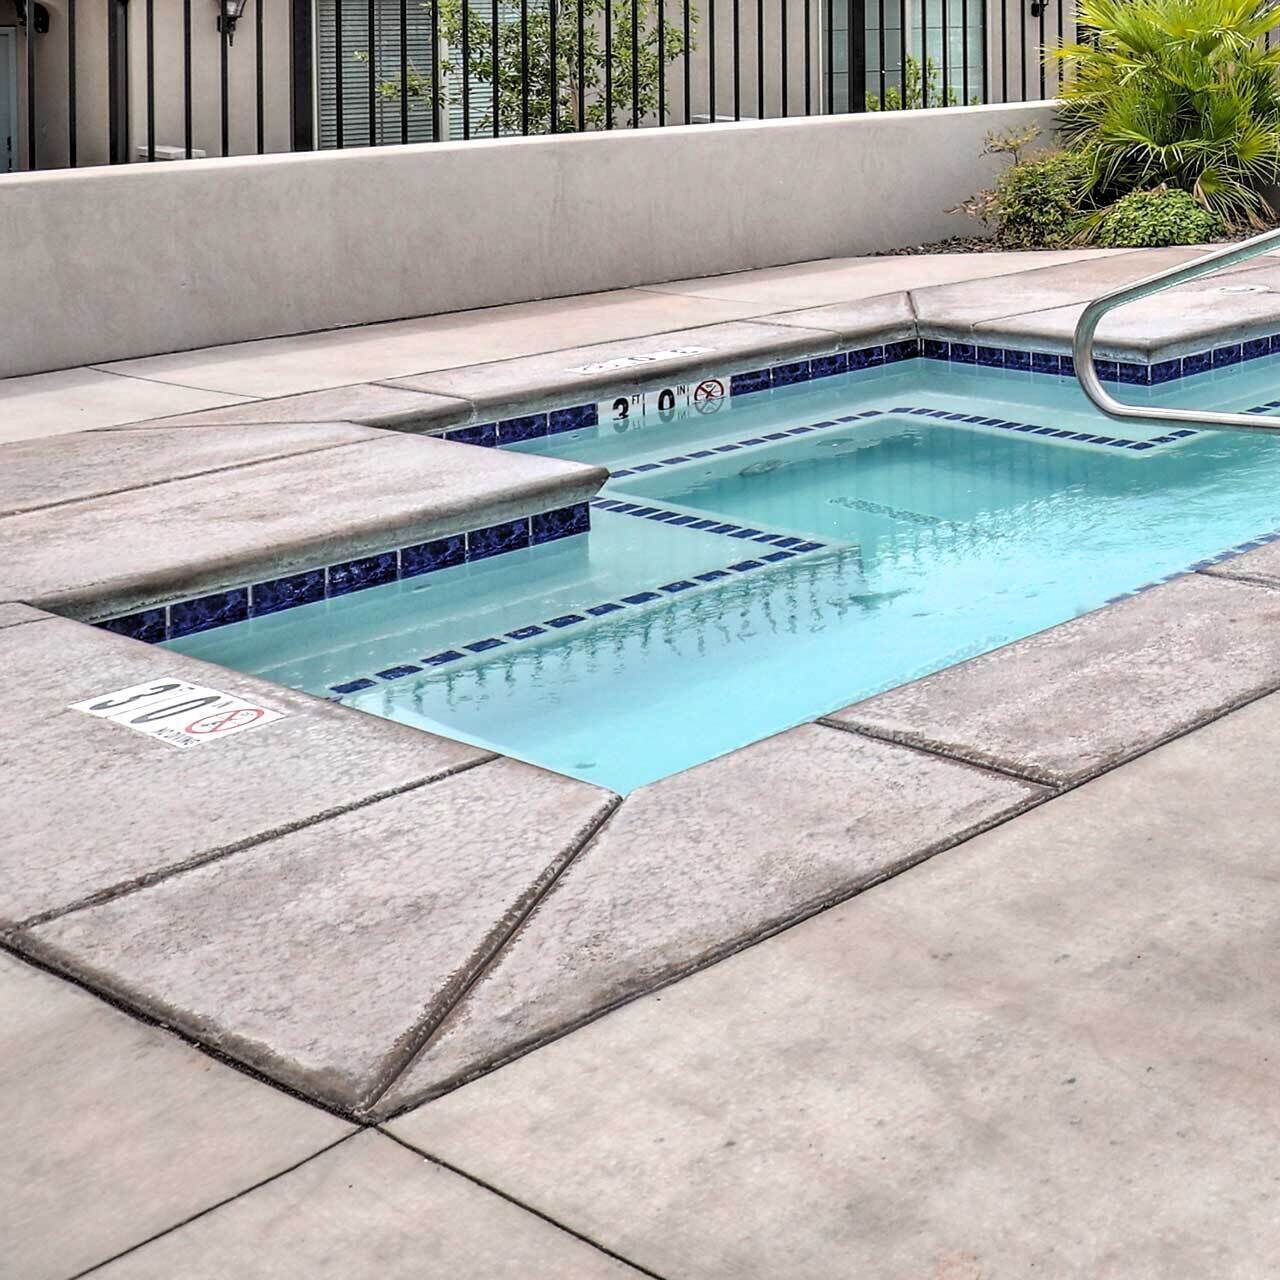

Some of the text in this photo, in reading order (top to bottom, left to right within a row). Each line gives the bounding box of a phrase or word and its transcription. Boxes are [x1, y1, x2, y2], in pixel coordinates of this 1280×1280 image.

[612, 384, 686, 421] 3 FT 0 IN
[89, 683, 222, 724] 3 0
